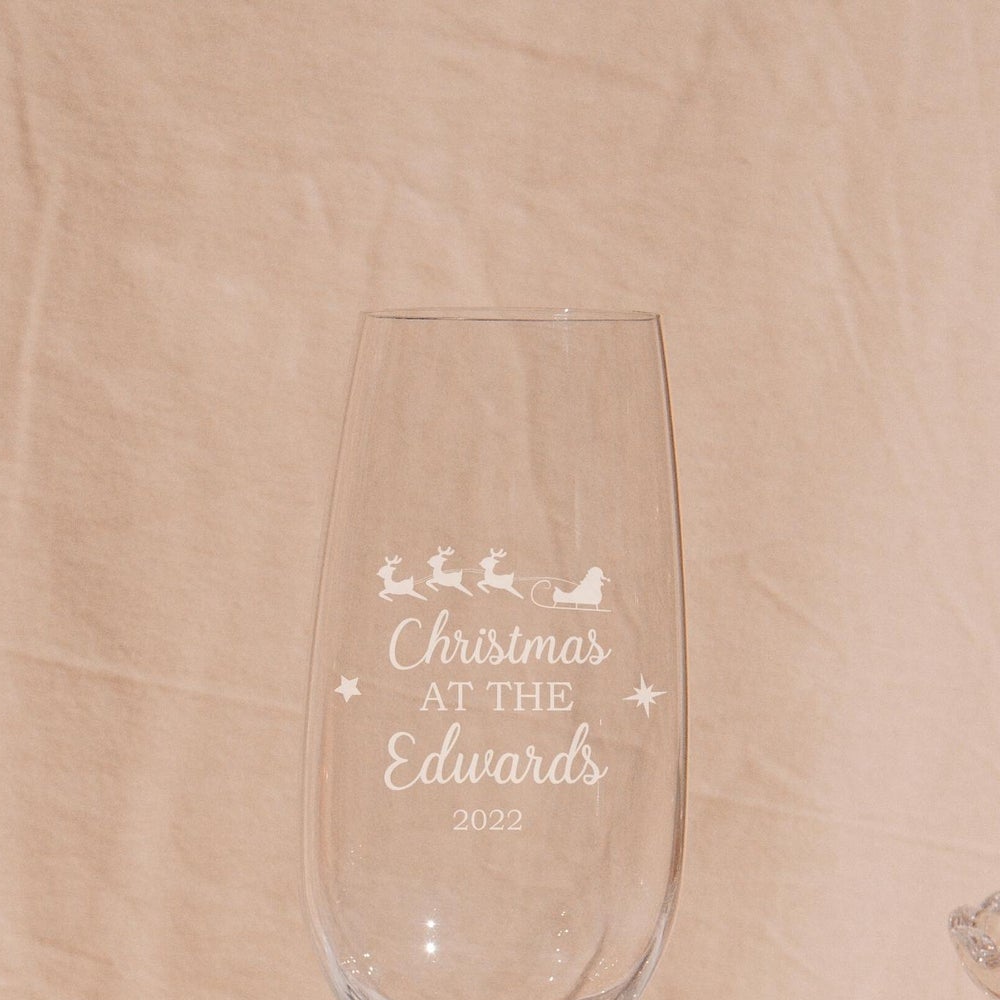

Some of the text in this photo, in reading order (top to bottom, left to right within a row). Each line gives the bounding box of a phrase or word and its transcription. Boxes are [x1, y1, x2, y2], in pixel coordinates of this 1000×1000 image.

[388, 608, 613, 671] Christmas
[419, 681, 575, 712] AT THE
[383, 722, 609, 792] Edwards
[452, 809, 523, 832] 2022
